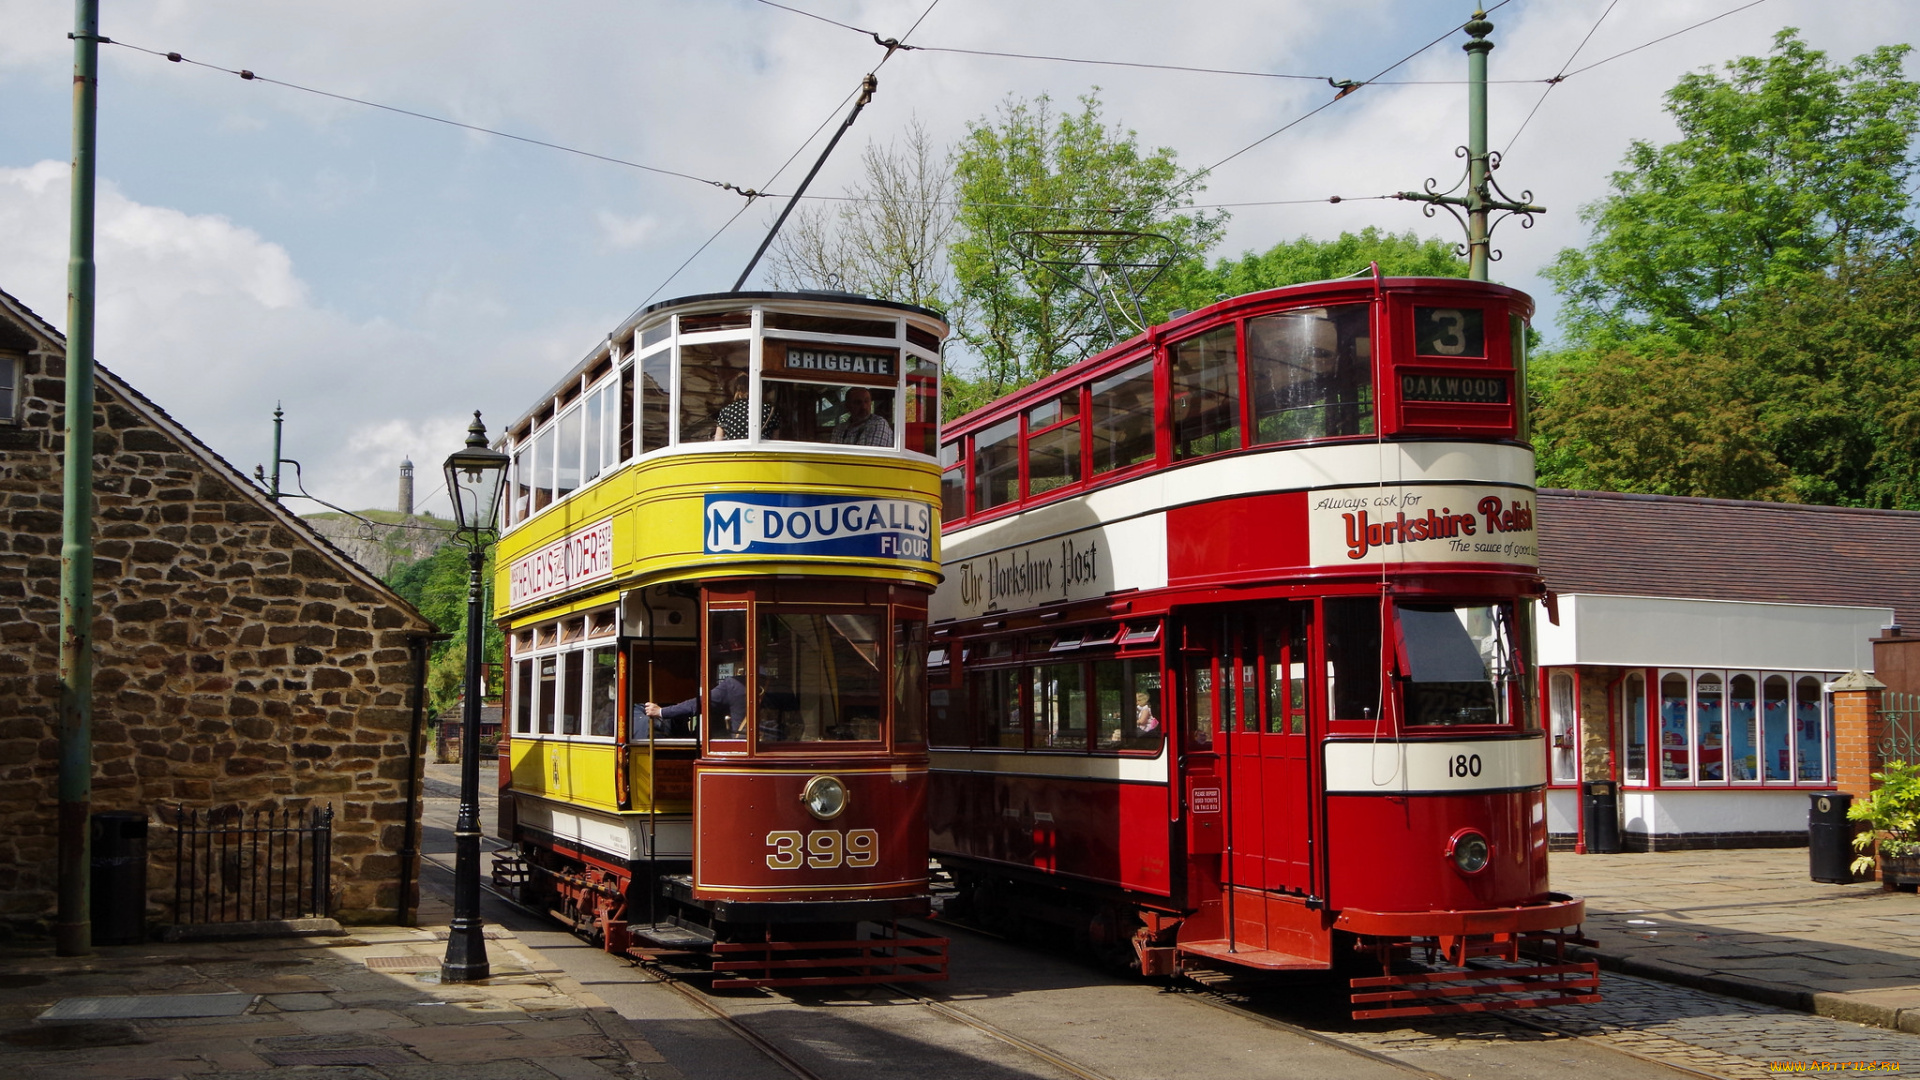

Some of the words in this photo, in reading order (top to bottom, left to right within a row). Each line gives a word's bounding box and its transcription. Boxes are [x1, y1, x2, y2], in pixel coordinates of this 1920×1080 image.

[1431, 308, 1466, 355] 3
[788, 350, 889, 374] BRIGGATE
[1402, 376, 1499, 397] OAKWOOD
[1314, 497, 1368, 512] Always
[1373, 494, 1398, 507] ask
[1401, 492, 1422, 509] for
[1341, 507, 1476, 560] Yorkshire
[1477, 495, 1534, 535] Relish
[564, 532, 598, 582] CYDER
[881, 536, 929, 558] FLOUR
[1449, 539, 1471, 552] The
[1474, 543, 1502, 552] sauce
[1504, 541, 1514, 556] of
[960, 561, 983, 612] The
[988, 549, 1053, 611] Yorkshire
[1061, 538, 1097, 596] Post
[1449, 754, 1482, 777] 180
[766, 828, 879, 870] 399
